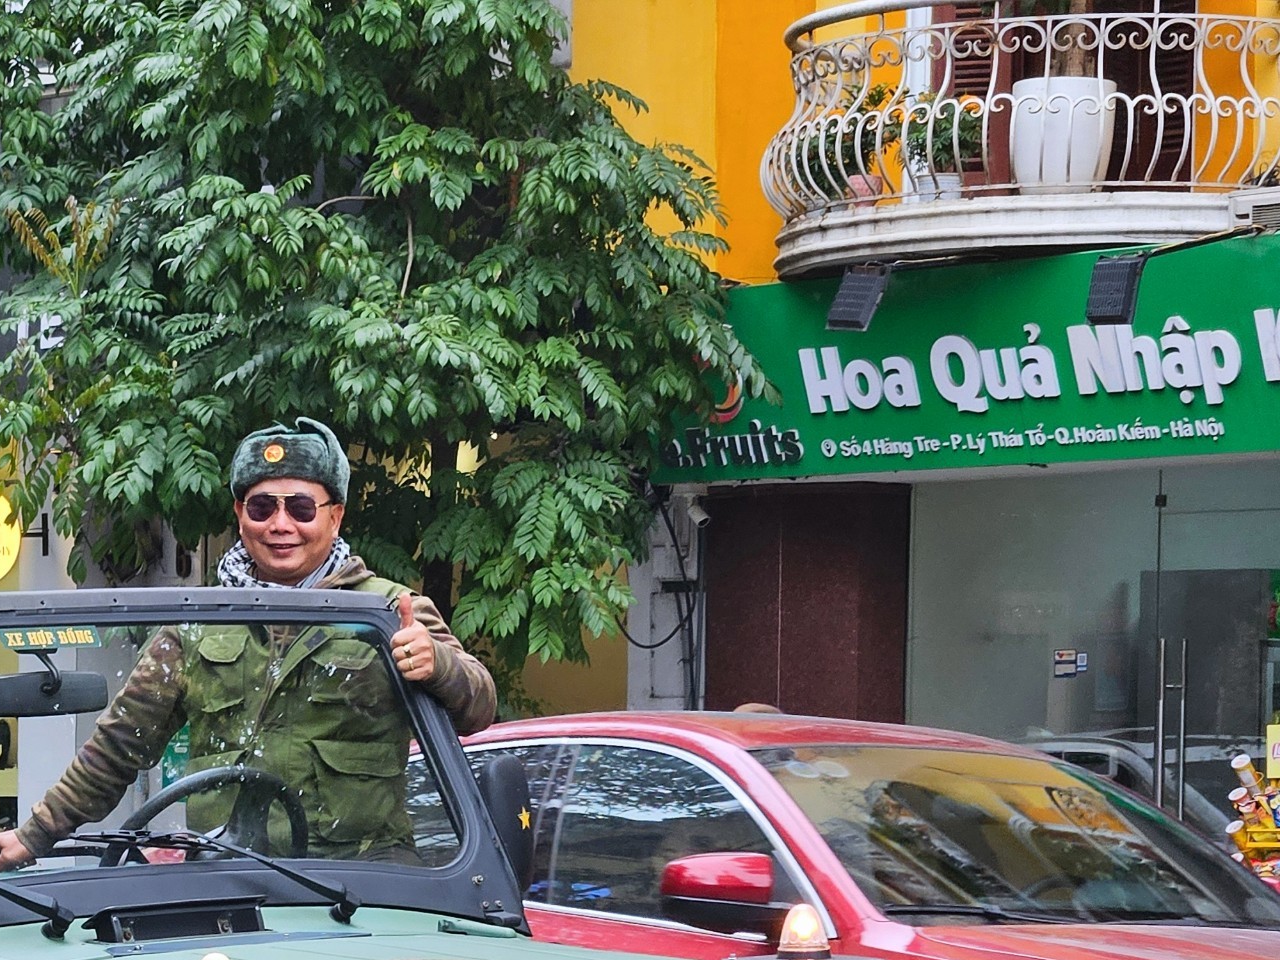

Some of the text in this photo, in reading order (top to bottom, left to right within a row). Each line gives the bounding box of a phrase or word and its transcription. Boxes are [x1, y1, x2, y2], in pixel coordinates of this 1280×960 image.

[798, 346, 921, 413] Hoa
[929, 322, 1062, 413] Quả
[1066, 315, 1242, 405] Nhập
[839, 435, 862, 457] Số
[862, 439, 873, 455] 4
[913, 436, 941, 452] Tre
[987, 427, 1024, 449] Thái
[1117, 416, 1161, 441] Kiếm
[1170, 417, 1193, 438] Hà
[1194, 416, 1225, 441] Nội
[4, 626, 95, 649] XE HỢP ĐỒNG
